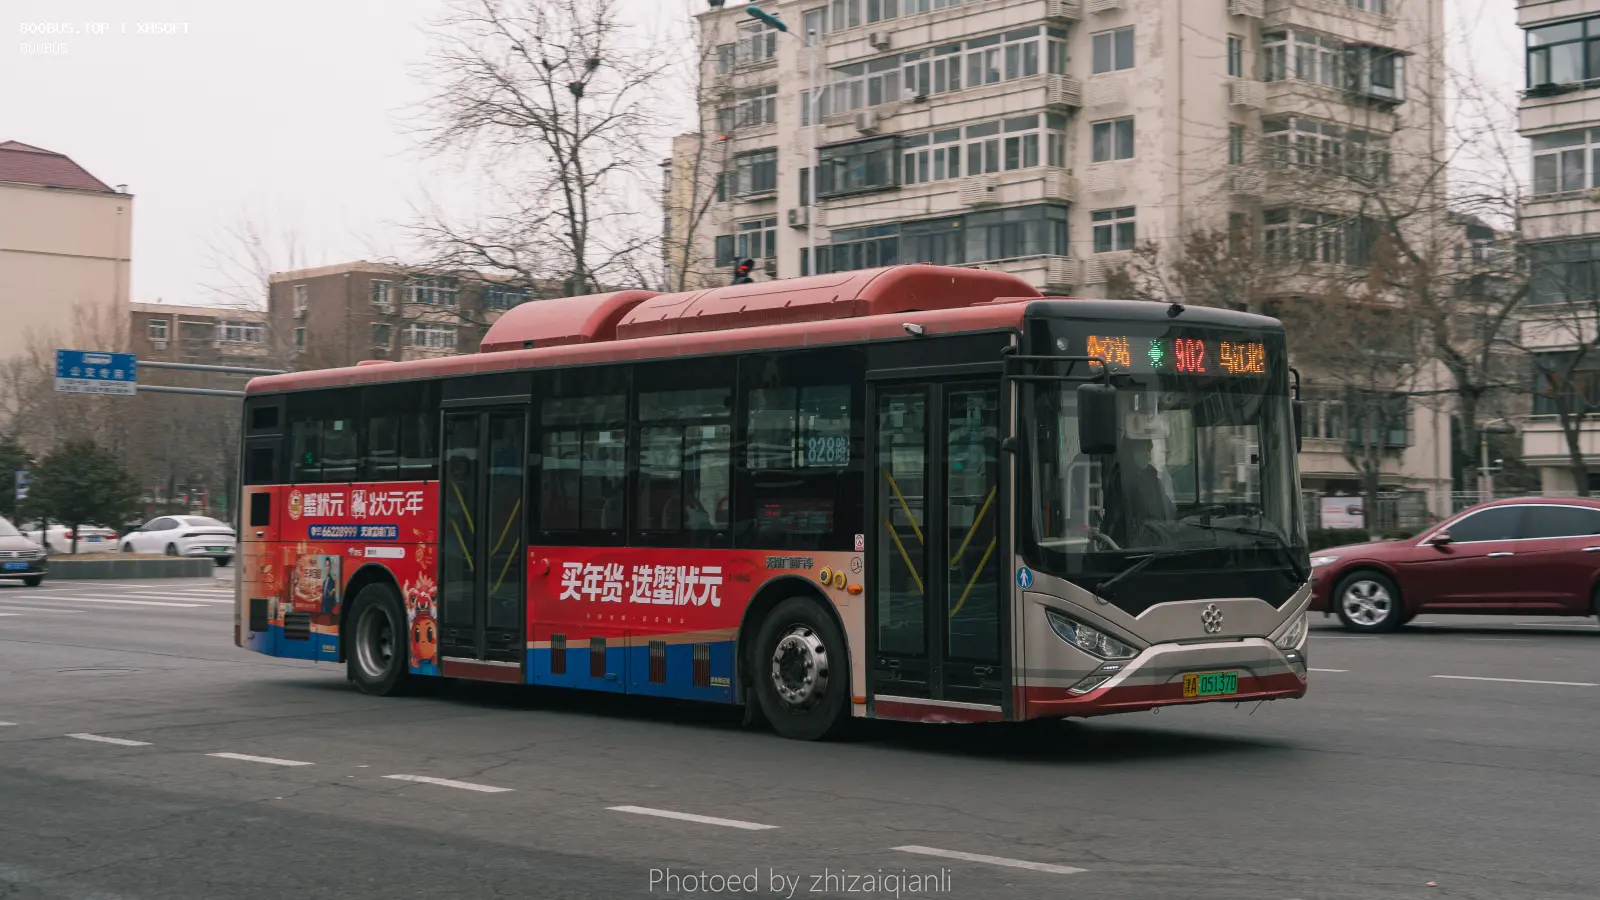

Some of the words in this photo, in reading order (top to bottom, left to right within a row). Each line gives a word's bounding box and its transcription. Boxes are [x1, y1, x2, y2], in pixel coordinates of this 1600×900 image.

[1175, 338, 1206, 372] 902
[808, 436, 846, 462] 828路
[303, 492, 344, 517] 蟹状元
[560, 562, 723, 608] 买年货·选蟹状元
